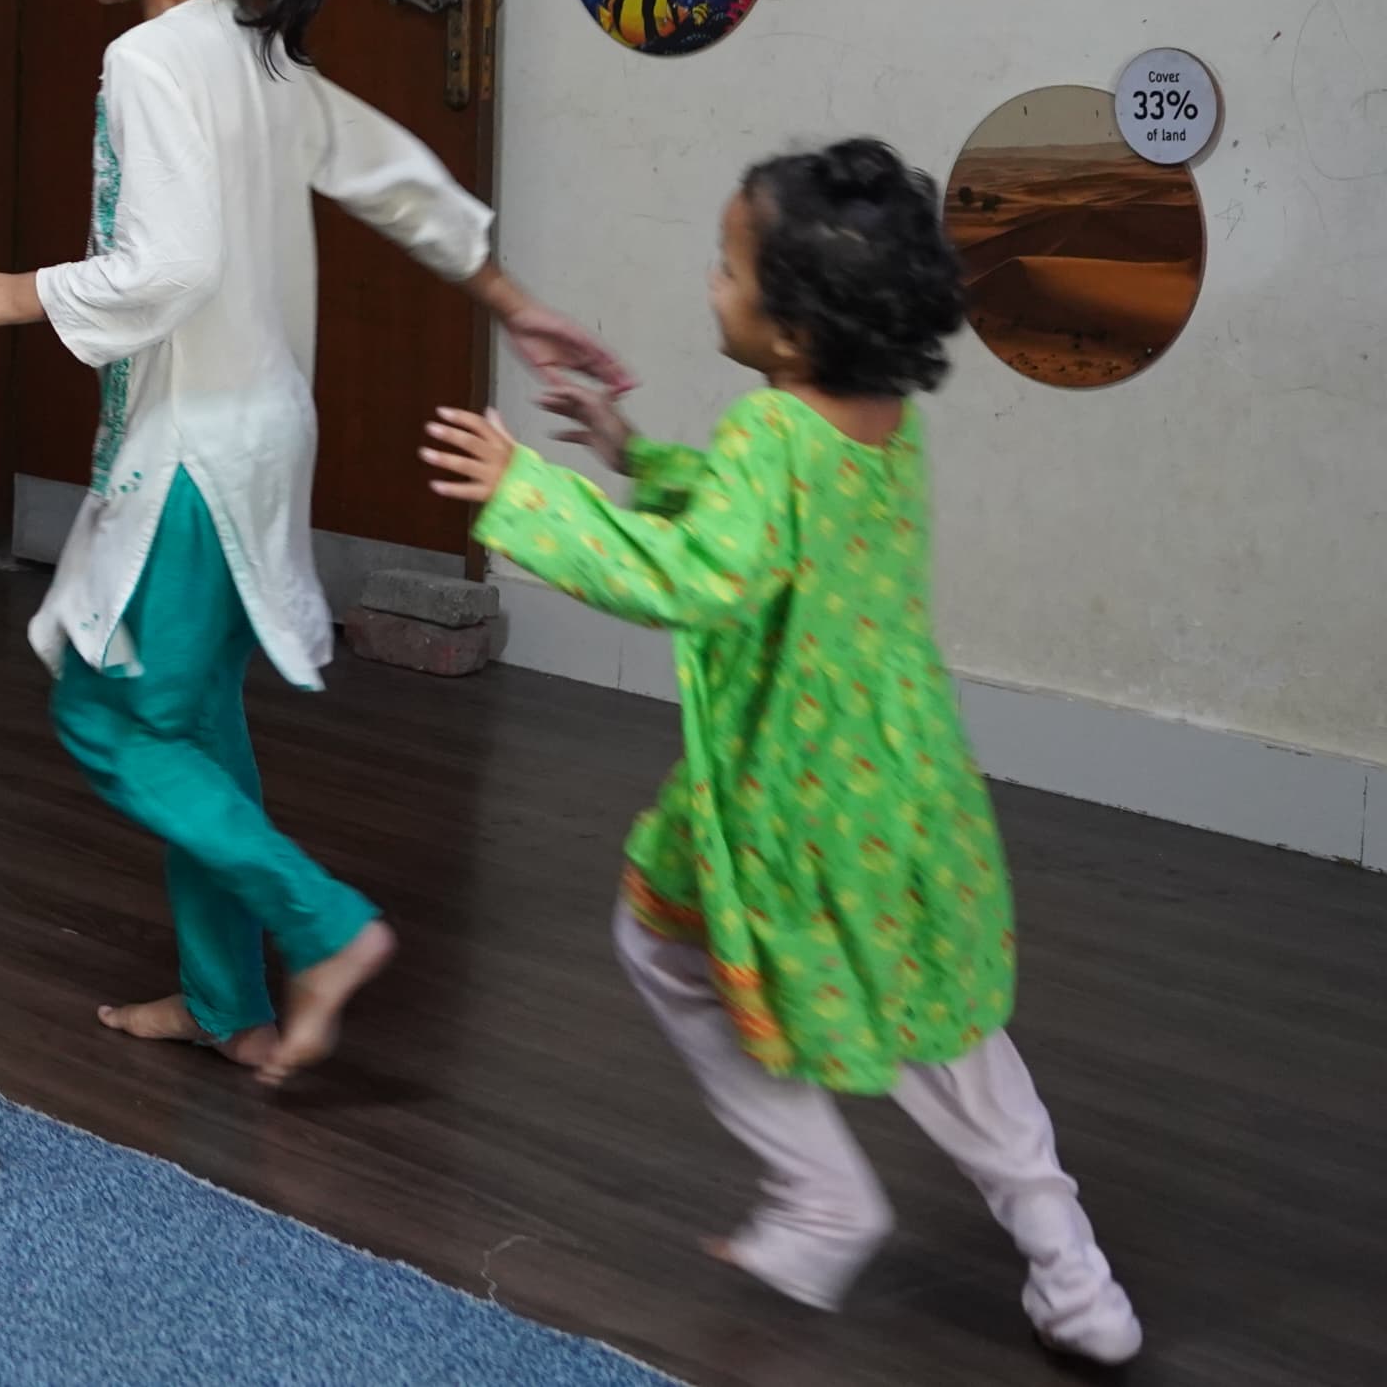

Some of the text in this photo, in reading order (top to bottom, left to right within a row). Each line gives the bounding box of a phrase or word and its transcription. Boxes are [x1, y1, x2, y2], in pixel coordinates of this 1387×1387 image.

[1148, 70, 1181, 83] Cover
[1132, 89, 1199, 121] 33%
[1147, 128, 1187, 142] of land
